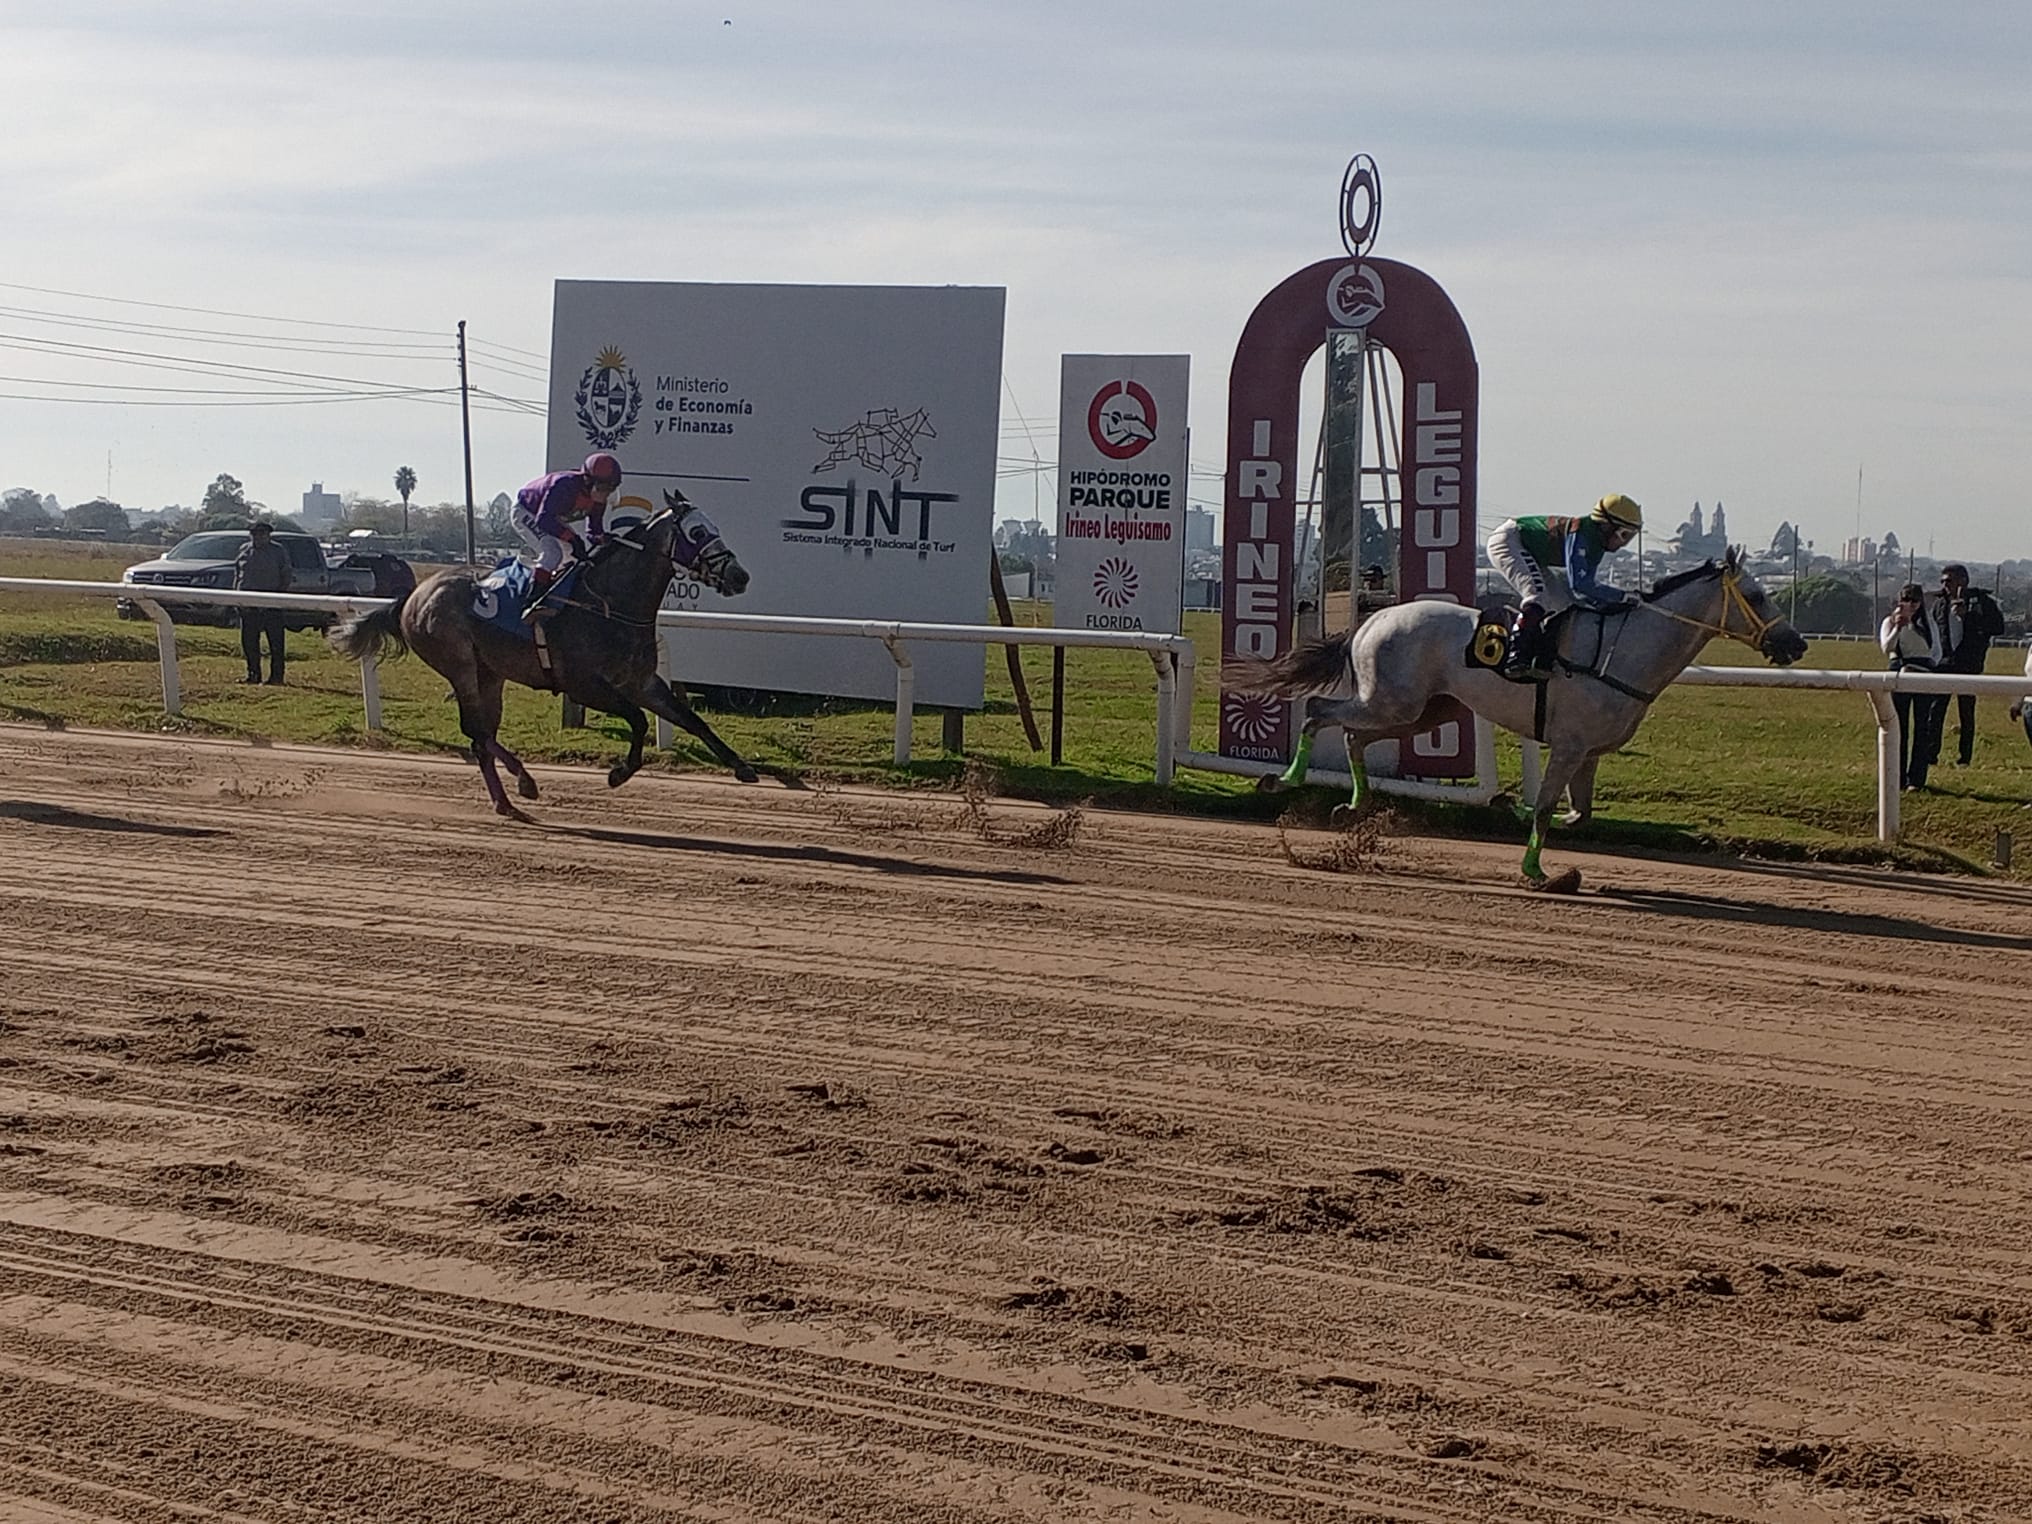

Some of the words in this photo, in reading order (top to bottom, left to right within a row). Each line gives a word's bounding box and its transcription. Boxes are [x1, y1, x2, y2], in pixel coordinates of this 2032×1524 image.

[656, 375, 729, 393] Ministerio
[655, 396, 674, 411] de
[679, 397, 753, 415] Economía
[655, 419, 665, 435] y
[668, 416, 734, 434] Finanzas
[1070, 468, 1171, 487] HIPÓDROMO
[1070, 487, 1171, 509] PARQUE
[781, 479, 959, 540] SINT
[1065, 510, 1101, 538] Irineo
[1104, 512, 1171, 545] Leguisamo
[782, 532, 823, 544] Sistema
[824, 535, 872, 548] Integrado
[873, 538, 917, 550] Nacional
[918, 541, 931, 551] de
[932, 542, 955, 552] Turf
[1235, 420, 1282, 660] IRINEO
[1086, 614, 1143, 630] FLORIDA
[1474, 624, 1509, 666] 6
[1229, 745, 1279, 760] FLORIDA
